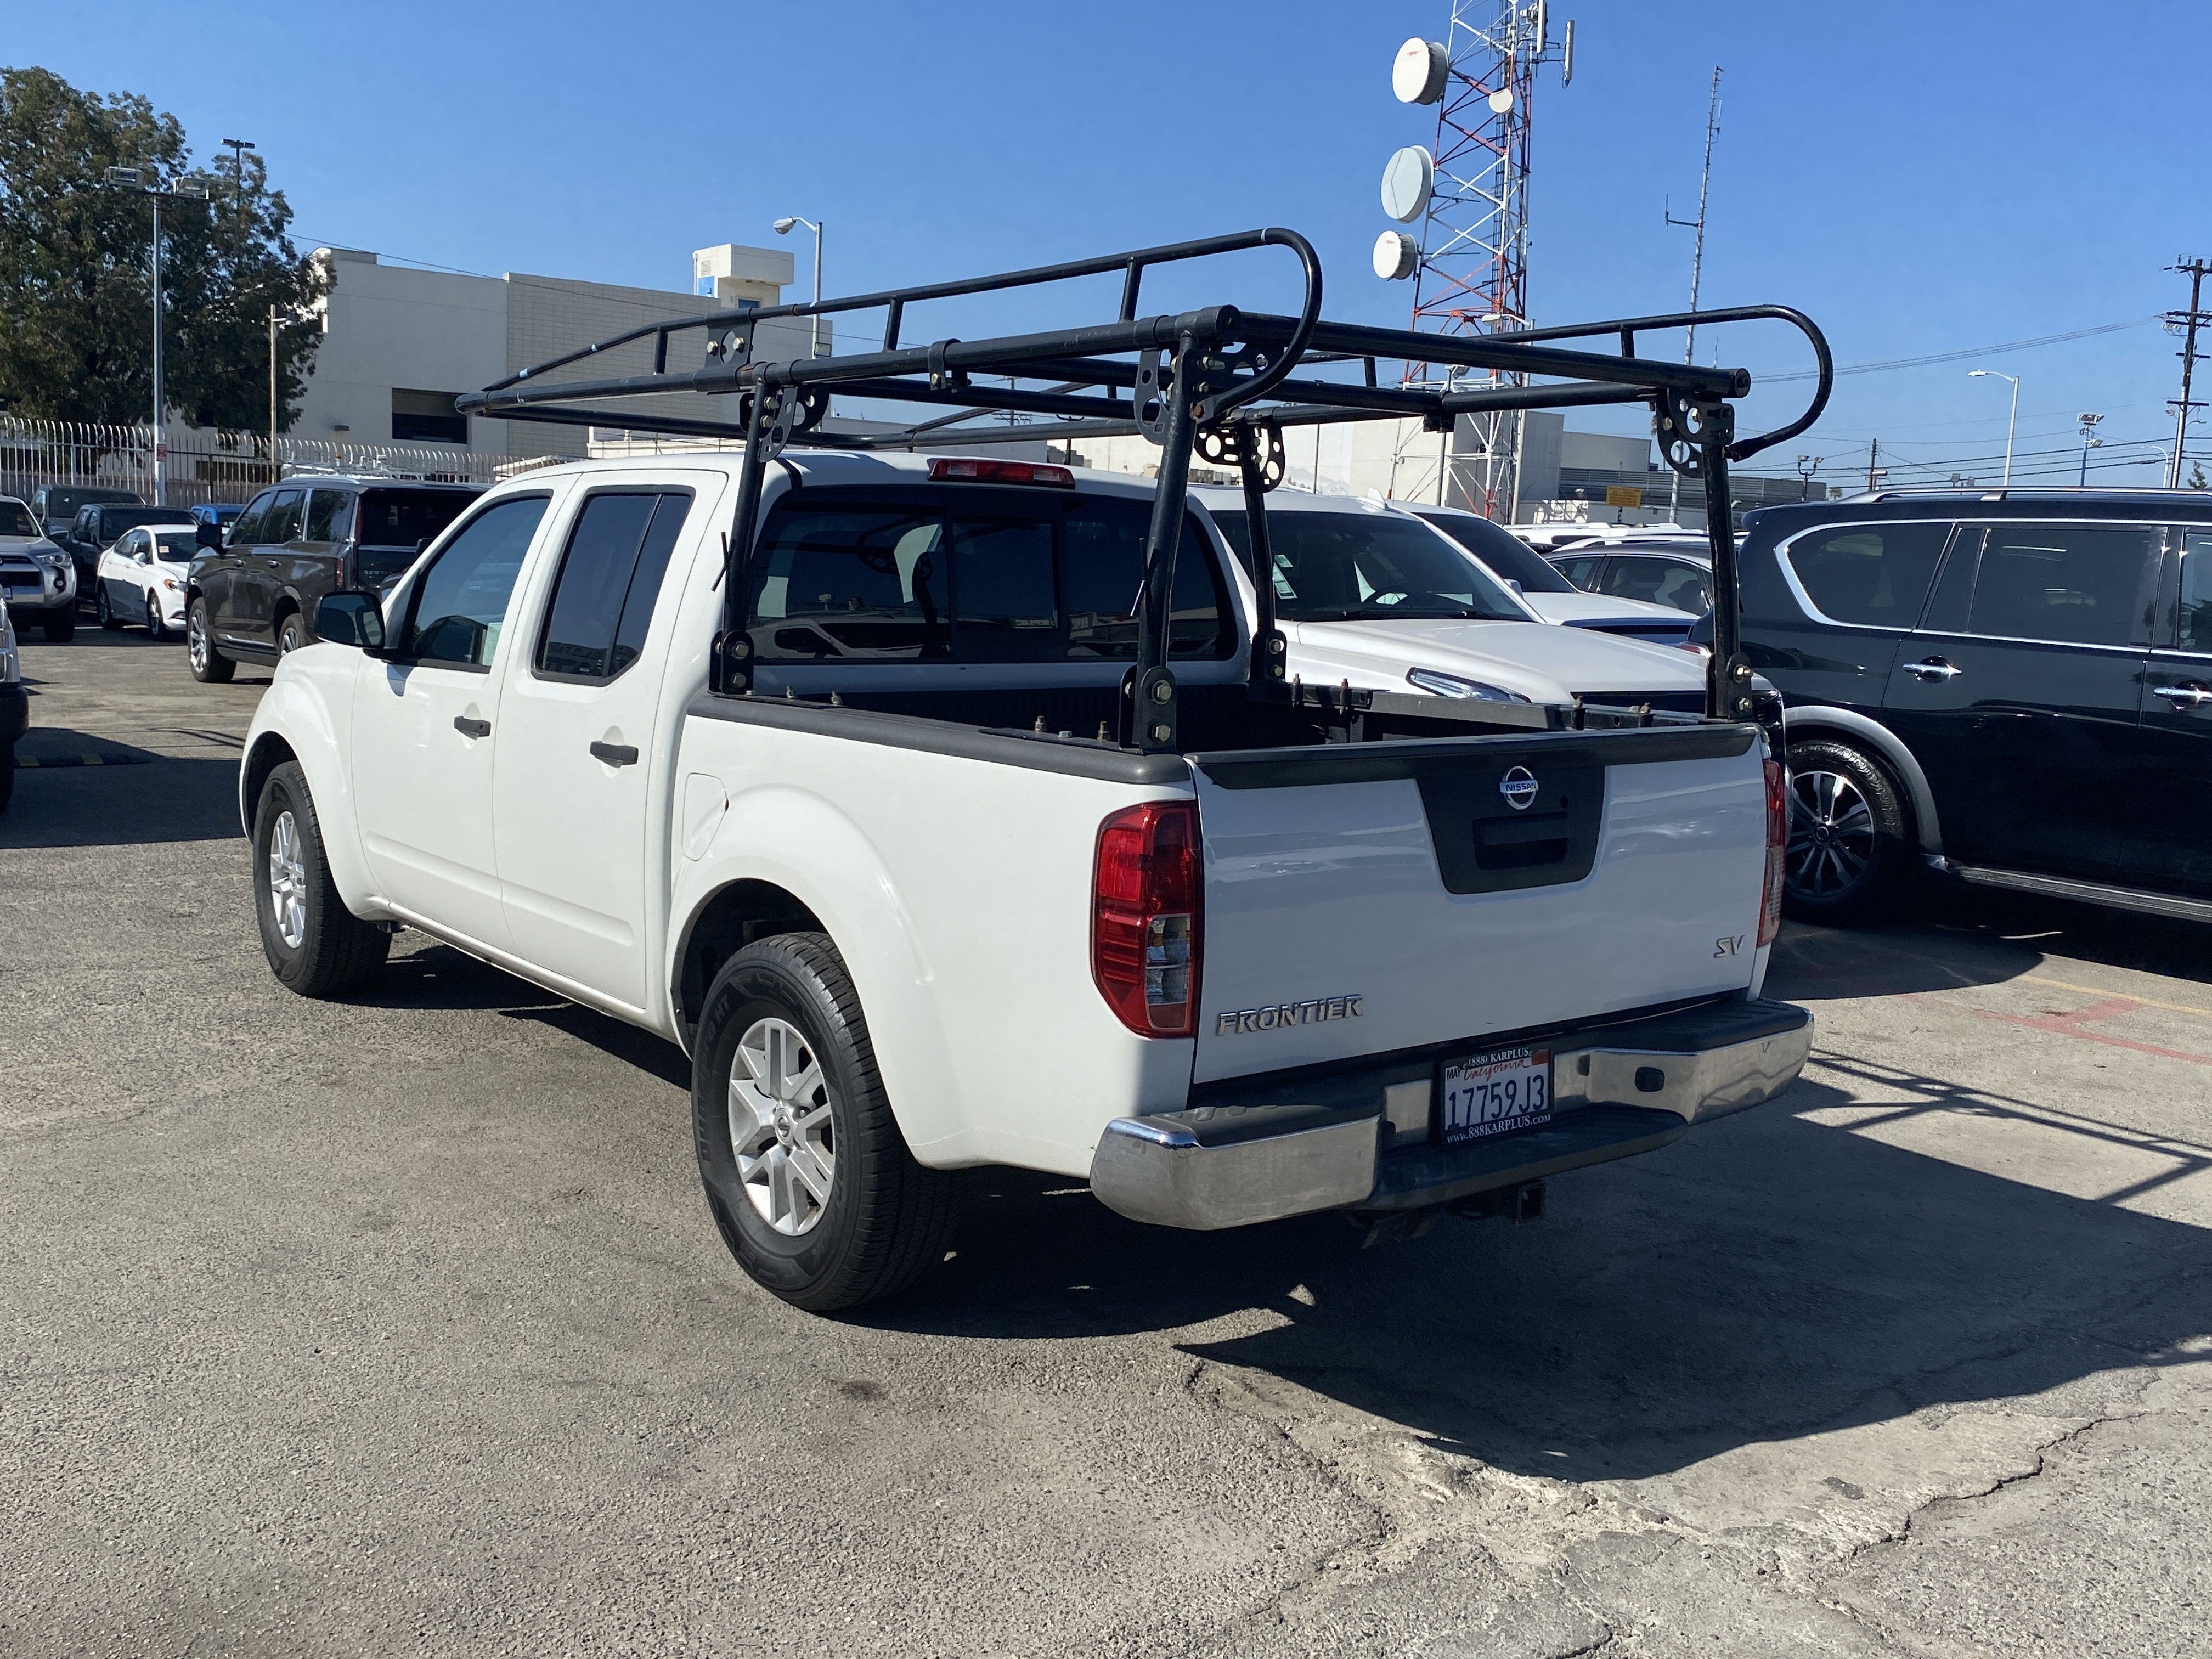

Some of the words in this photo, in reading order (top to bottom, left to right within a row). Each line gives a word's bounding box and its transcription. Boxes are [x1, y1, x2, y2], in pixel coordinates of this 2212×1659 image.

[1505, 782, 1536, 792] NISSAN
[1713, 934, 1745, 958] SV
[1216, 994, 1364, 1036] FRONTIER
[1468, 1056, 1488, 1068] (888)
[1489, 1047, 1530, 1063] KARPLUS
[1447, 1068, 1461, 1080] MAY
[1463, 1058, 1533, 1082] California
[1447, 1074, 1545, 1130] 17759J3
